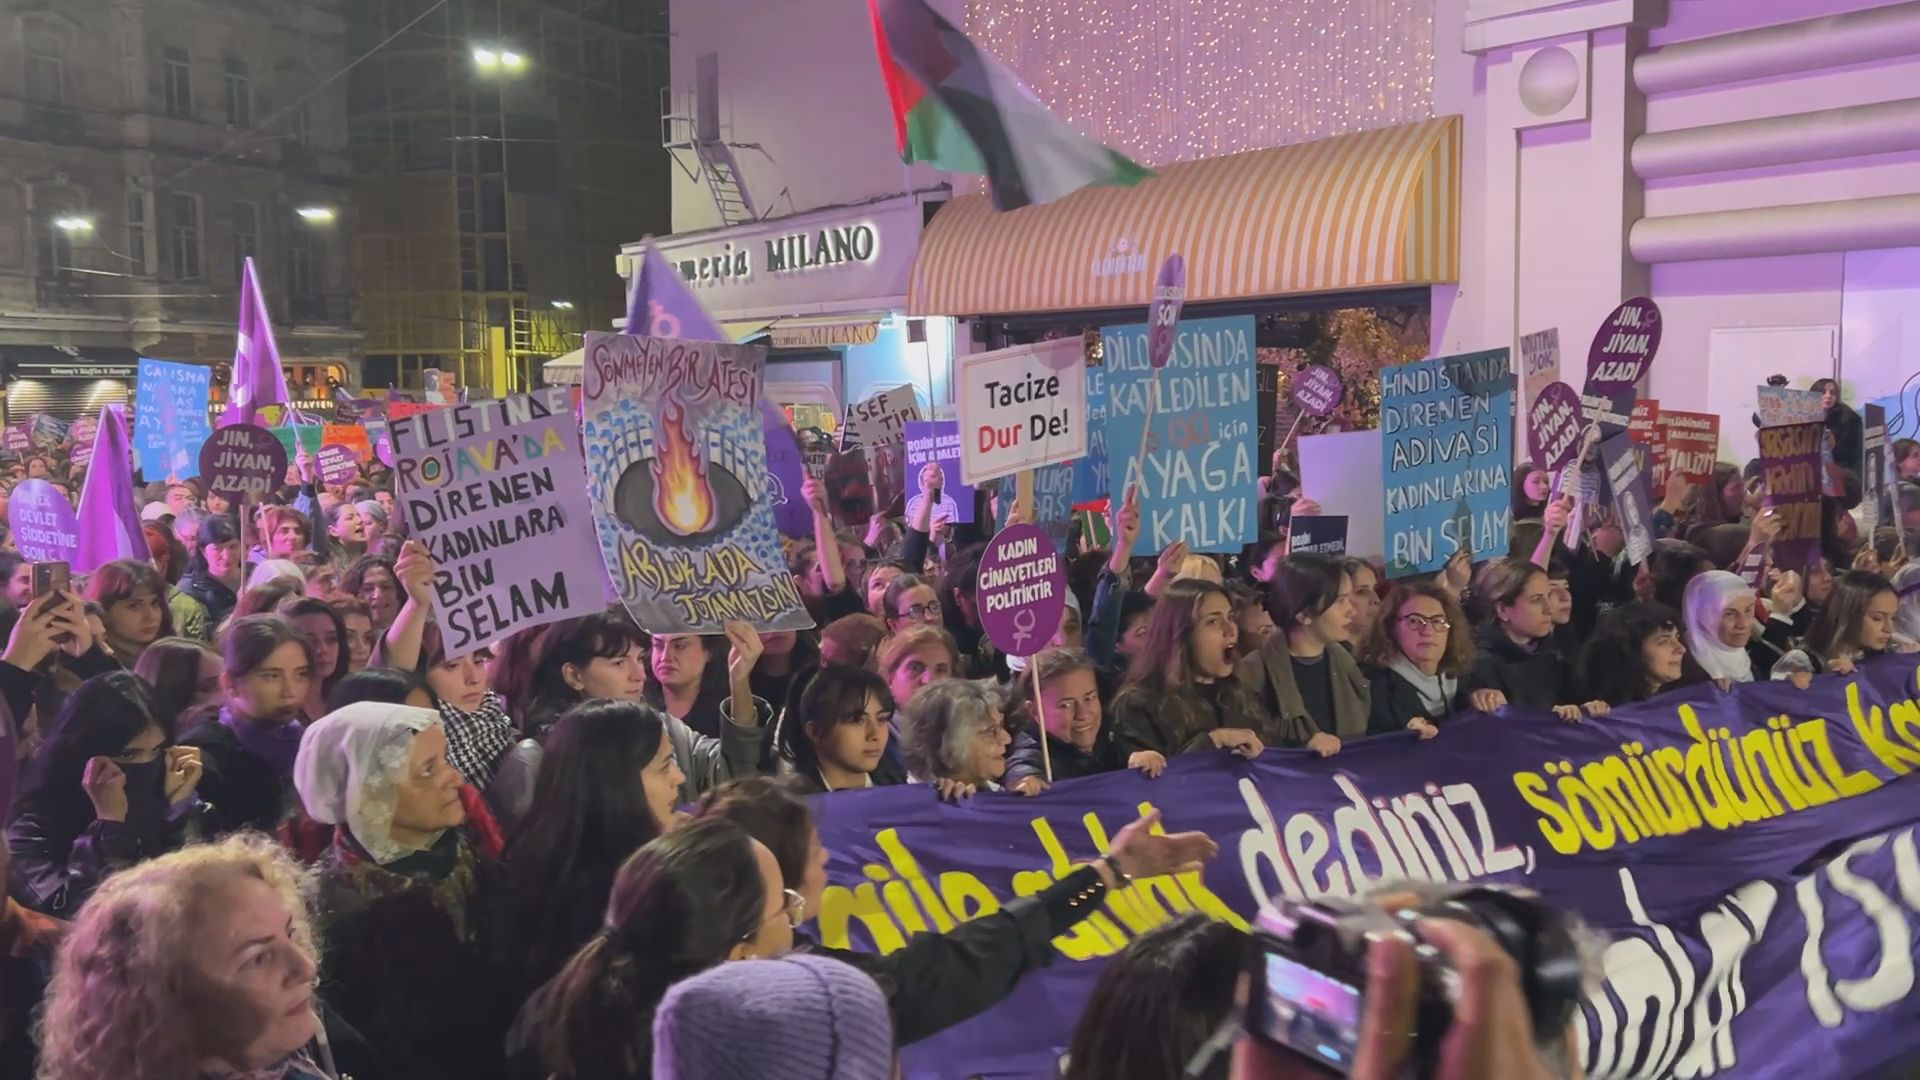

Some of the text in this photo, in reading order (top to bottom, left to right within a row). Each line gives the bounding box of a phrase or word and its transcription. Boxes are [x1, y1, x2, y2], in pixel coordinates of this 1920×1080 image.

[764, 226, 875, 273] MILANO
[810, 322, 877, 345] MILANO
[1613, 306, 1642, 329] JIN,
[1529, 351, 1555, 376] YOK
[1602, 328, 1651, 357] JİYAN,
[984, 372, 1060, 409] Tacize
[1382, 357, 1510, 399] HİNDİSTANDA
[1591, 357, 1643, 382] AZADİ
[1109, 368, 1250, 418] KATLEDİLEN
[1385, 391, 1491, 435] DİRENEN
[216, 429, 255, 450] JIN,
[978, 423, 1023, 454] Dur
[1030, 408, 1068, 442] De!
[1218, 419, 1249, 441] için
[1391, 417, 1499, 474] ADİVASİ
[212, 447, 276, 474] JİYAN,
[396, 426, 566, 494] ROJAVA'DA
[1121, 440, 1251, 502] AYAĞA
[210, 473, 273, 495] AZADİ
[409, 467, 554, 532] DİRENEN
[1385, 463, 1509, 516] KADINLARINA
[18, 508, 58, 528] DEVLET
[421, 504, 565, 565] KADINLARA
[1151, 497, 1246, 552] KALK!
[1394, 504, 1510, 570] BİN SELAM
[979, 552, 1057, 590] CİNAYETLERİ
[997, 537, 1038, 563] KADIN
[433, 558, 495, 608] BİN
[986, 579, 1053, 614] POLİTİKTİR
[447, 571, 569, 650] SELAM
[1238, 774, 1537, 918] dediniz,
[1512, 702, 1886, 856] sömürdünüz
